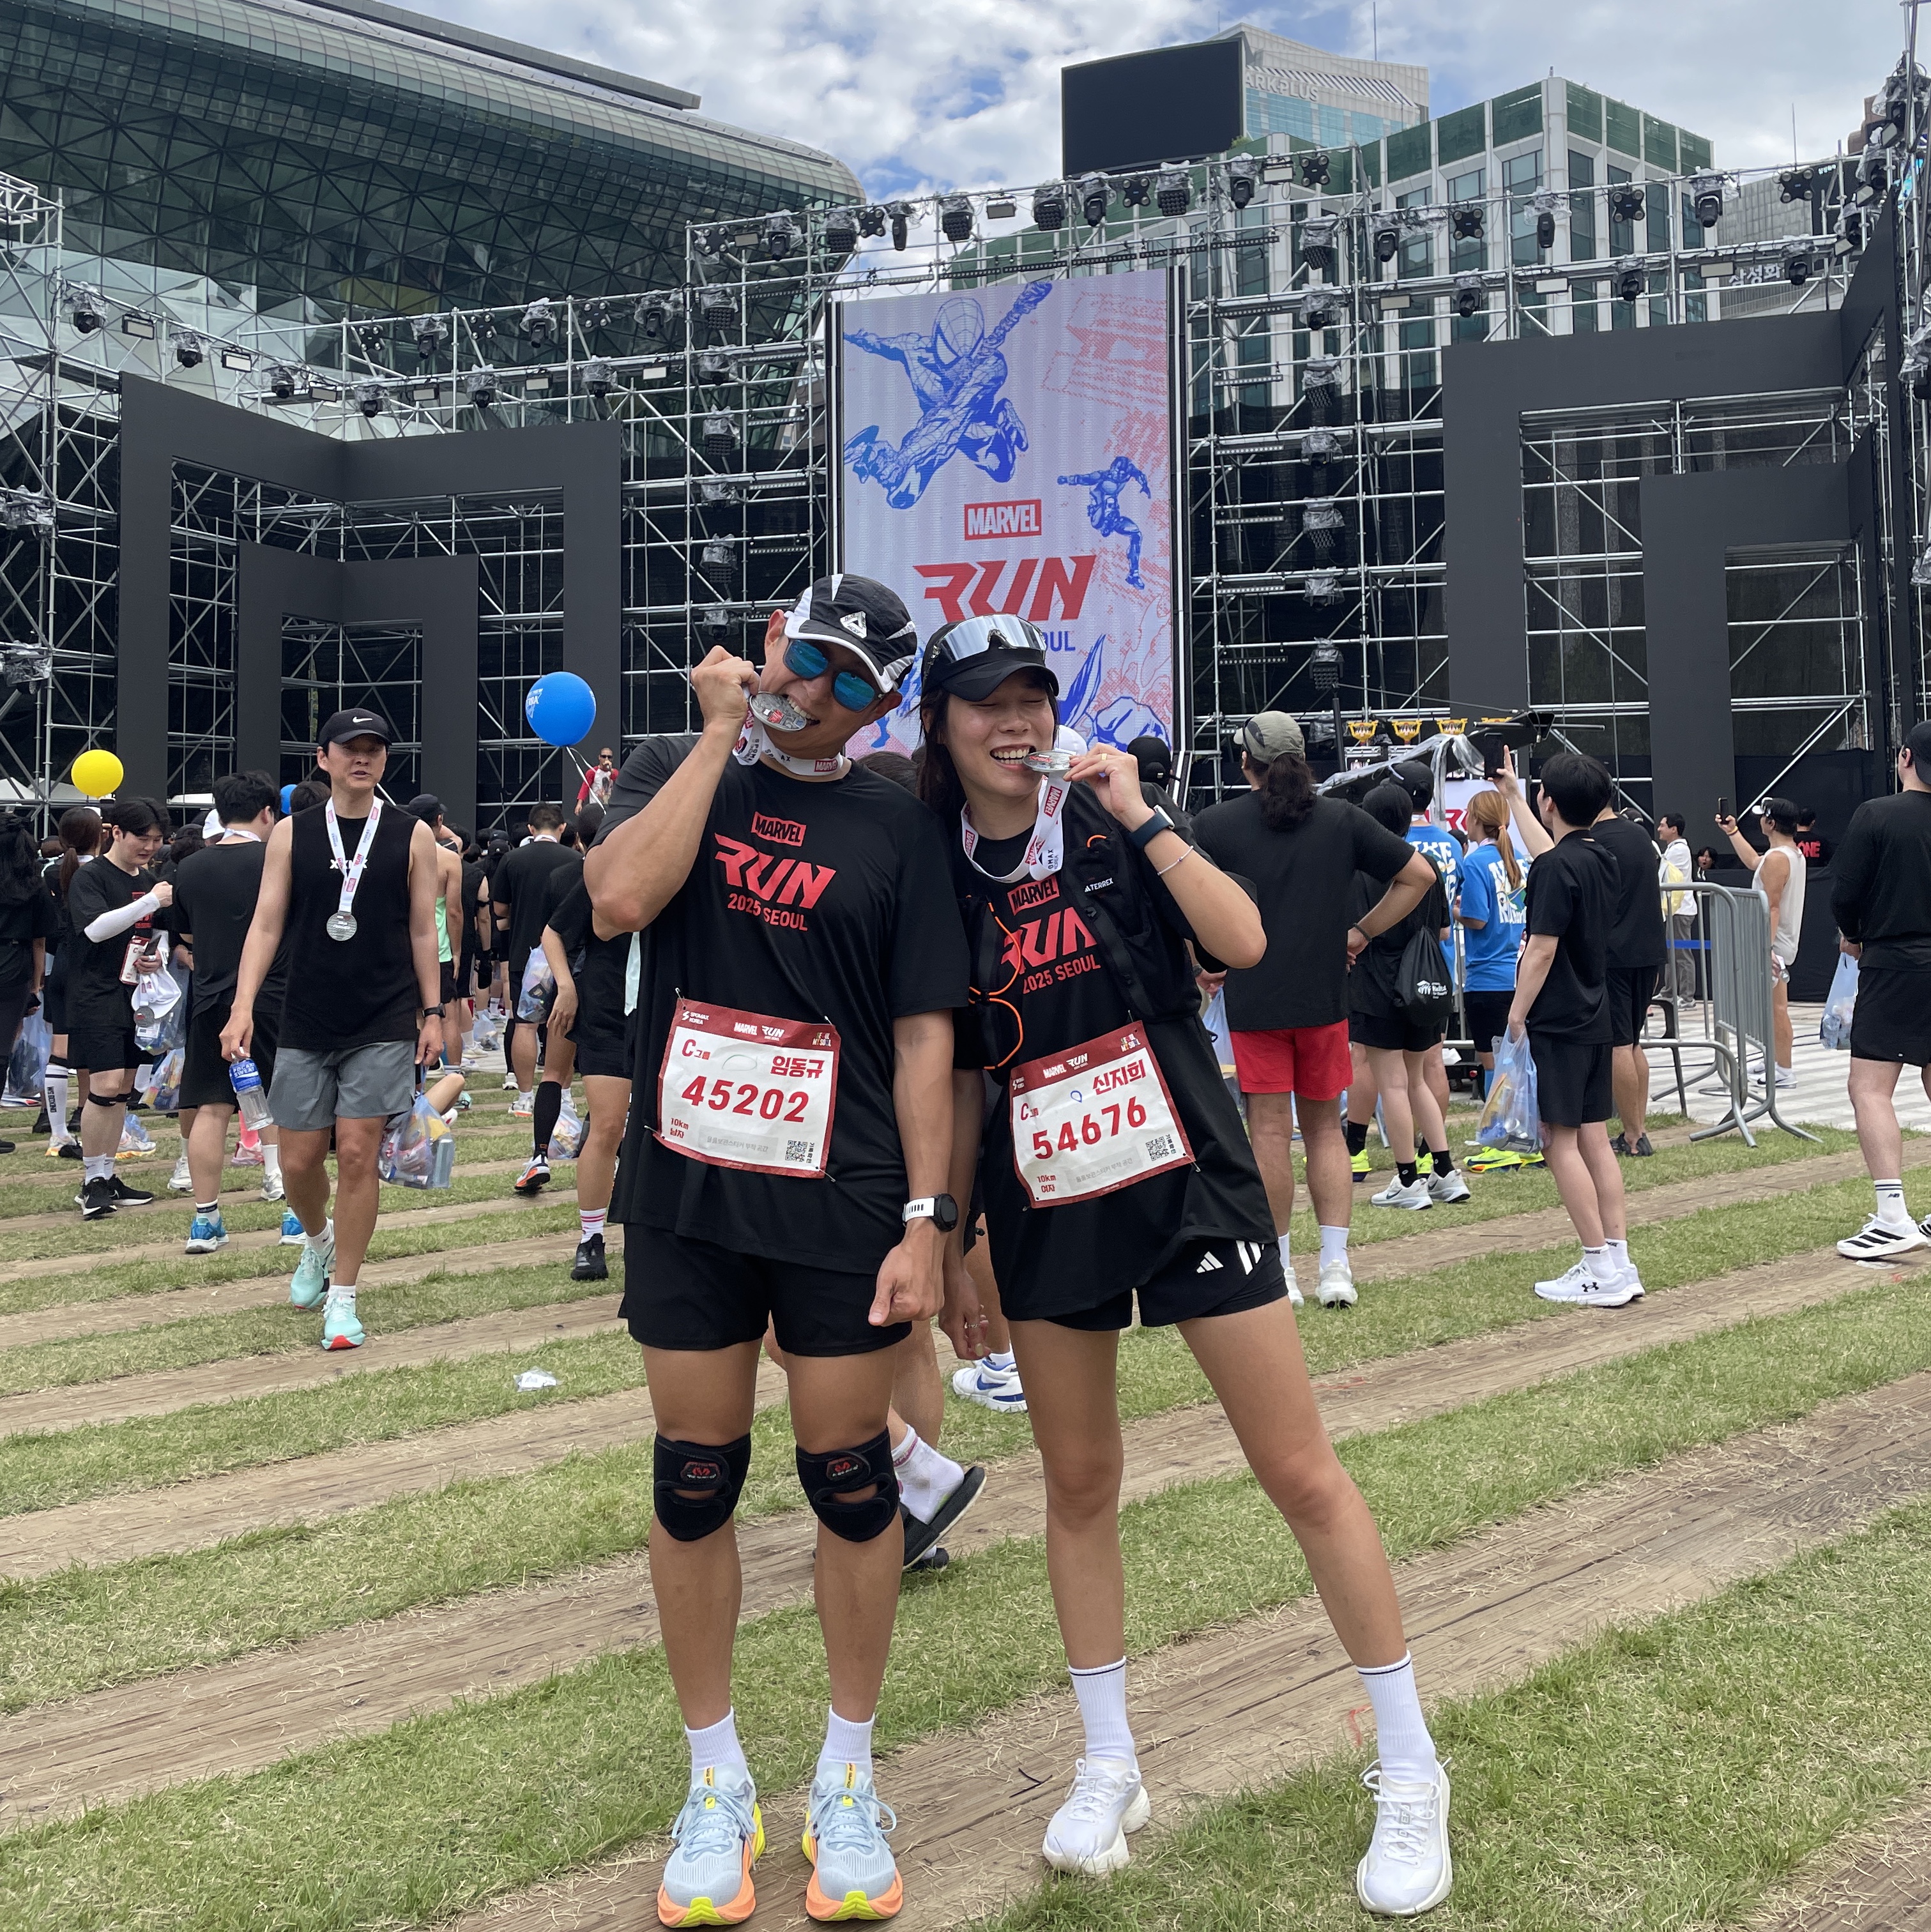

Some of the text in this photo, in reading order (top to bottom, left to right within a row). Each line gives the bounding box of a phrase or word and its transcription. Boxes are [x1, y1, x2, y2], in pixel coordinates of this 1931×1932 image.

[1245, 72, 1319, 102] ARKPLUS
[1729, 262, 1786, 286] 삼성화
[968, 504, 1040, 535] MARVEL
[913, 555, 1097, 622] RUN
[754, 816, 801, 842] MARVEL
[1409, 841, 1452, 862] IKE
[714, 832, 837, 909] RUN
[1090, 878, 1114, 891] TERREX
[1011, 879, 1058, 911] MARVEL
[728, 893, 808, 931] 2025 SEOUL
[1023, 954, 1101, 994] 2025 SEOUL
[734, 1022, 785, 1038] MARVEL RUN
[770, 1055, 825, 1079] 임동규
[1042, 1063, 1067, 1079] MARVEL
[1066, 1053, 1088, 1067] RUN
[1092, 1059, 1147, 1095] 신지희
[682, 1075, 809, 1123] 45202
[670, 1117, 689, 1130] 10km
[1032, 1095, 1147, 1160] 54676
[1037, 1175, 1057, 1183] 10km
